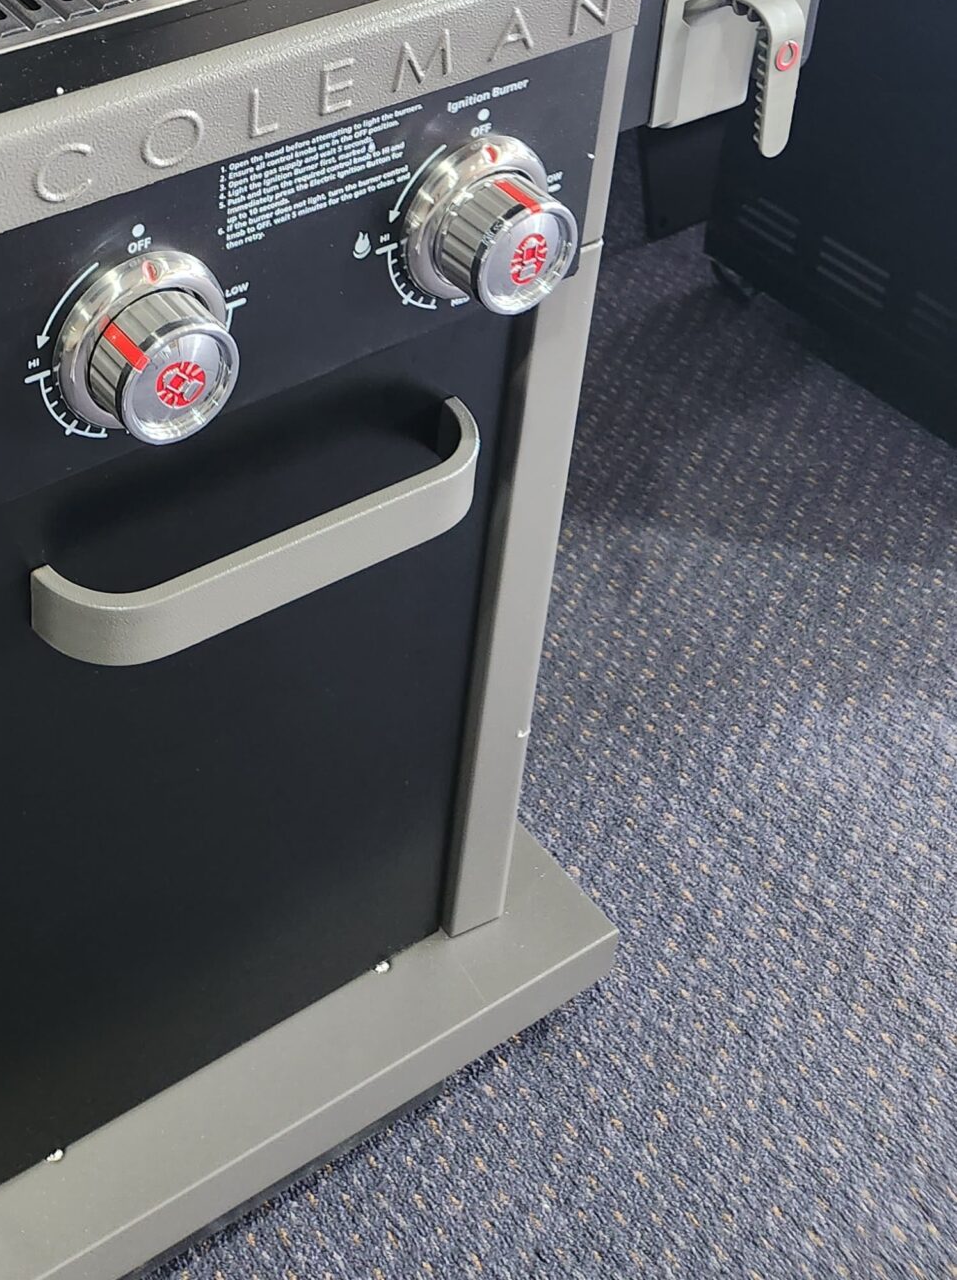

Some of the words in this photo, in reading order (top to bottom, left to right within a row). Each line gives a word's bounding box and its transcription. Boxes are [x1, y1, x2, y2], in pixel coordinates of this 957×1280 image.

[448, 91, 491, 113] Ignition
[492, 79, 530, 98] Burner
[229, 159, 249, 171] Open
[250, 155, 264, 164] the
[264, 146, 284, 159] hood
[285, 140, 310, 152] before
[311, 126, 353, 144] attempting
[362, 116, 380, 127] light
[381, 113, 394, 121] the
[470, 123, 492, 138] OFF
[228, 167, 254, 180] Ensure
[255, 161, 266, 171] all
[266, 152, 294, 167] control
[294, 146, 317, 158] knobs
[318, 142, 331, 150] are
[331, 137, 340, 146] in
[340, 132, 353, 143] the
[353, 128, 368, 139] OFF
[228, 177, 249, 189] Open
[249, 172, 263, 181] the
[263, 168, 277, 178] gas
[278, 159, 303, 172] supply
[304, 152, 319, 164] and
[319, 147, 336, 158] wait
[227, 195, 246, 206] Push
[246, 188, 262, 200] and
[262, 184, 279, 195] turn
[280, 180, 293, 189] the
[294, 167, 326, 184] required
[325, 158, 352, 173] control
[353, 150, 372, 164] knob
[372, 150, 381, 158] to
[381, 146, 390, 155] HI
[390, 141, 405, 152] and
[228, 185, 248, 198] Light
[249, 182, 262, 190] the
[263, 171, 293, 187] Ignition
[292, 162, 319, 176] Burner
[338, 145, 366, 161] marked
[273, 188, 295, 200] press
[295, 181, 309, 192] the
[308, 173, 336, 187] Electric
[337, 164, 366, 179] Ignition
[365, 155, 391, 168] Button
[391, 151, 403, 160] for
[546, 170, 563, 184] OW
[226, 222, 233, 232] If
[233, 221, 247, 230] the
[248, 211, 274, 225] burner
[274, 205, 292, 216] does
[293, 200, 307, 210] not
[328, 188, 344, 197] turn
[344, 183, 357, 192] the
[358, 175, 382, 187] burner
[382, 164, 409, 179] control
[226, 229, 246, 241] knob
[246, 226, 256, 234] to
[273, 213, 291, 225] wait
[296, 199, 327, 216] minutes
[328, 197, 340, 206] for
[340, 193, 353, 201] the
[353, 188, 367, 199] gas
[396, 172, 411, 183] and
[227, 215, 238, 224] up
[238, 212, 248, 220] to
[248, 207, 258, 216] 10
[128, 237, 152, 254] OFF
[226, 239, 244, 250] then
[379, 233, 391, 243] HI
[225, 282, 249, 298] LOW
[28, 358, 40, 369] HI
